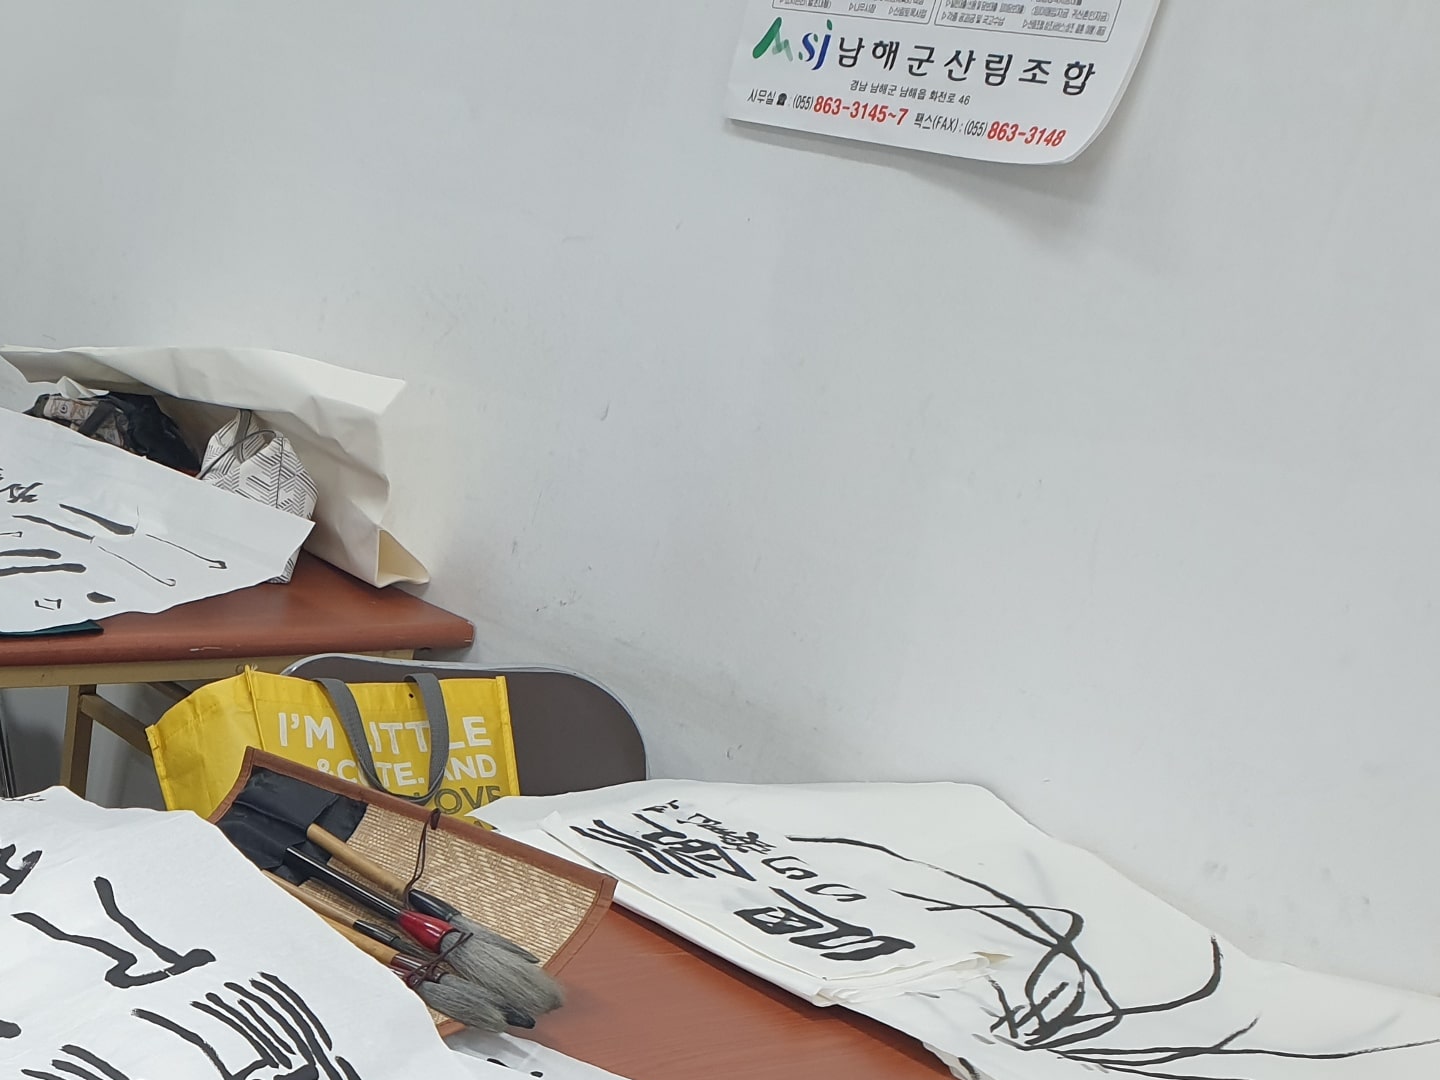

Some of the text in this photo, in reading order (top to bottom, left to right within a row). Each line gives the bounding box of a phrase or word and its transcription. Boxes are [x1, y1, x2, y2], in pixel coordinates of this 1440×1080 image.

[747, 88, 776, 106] 사무실
[849, 79, 971, 106] 경남 남해군 남해읍 화전로 46
[277, 711, 493, 755] I'M ITTE
[315, 758, 425, 788] &CTE.
